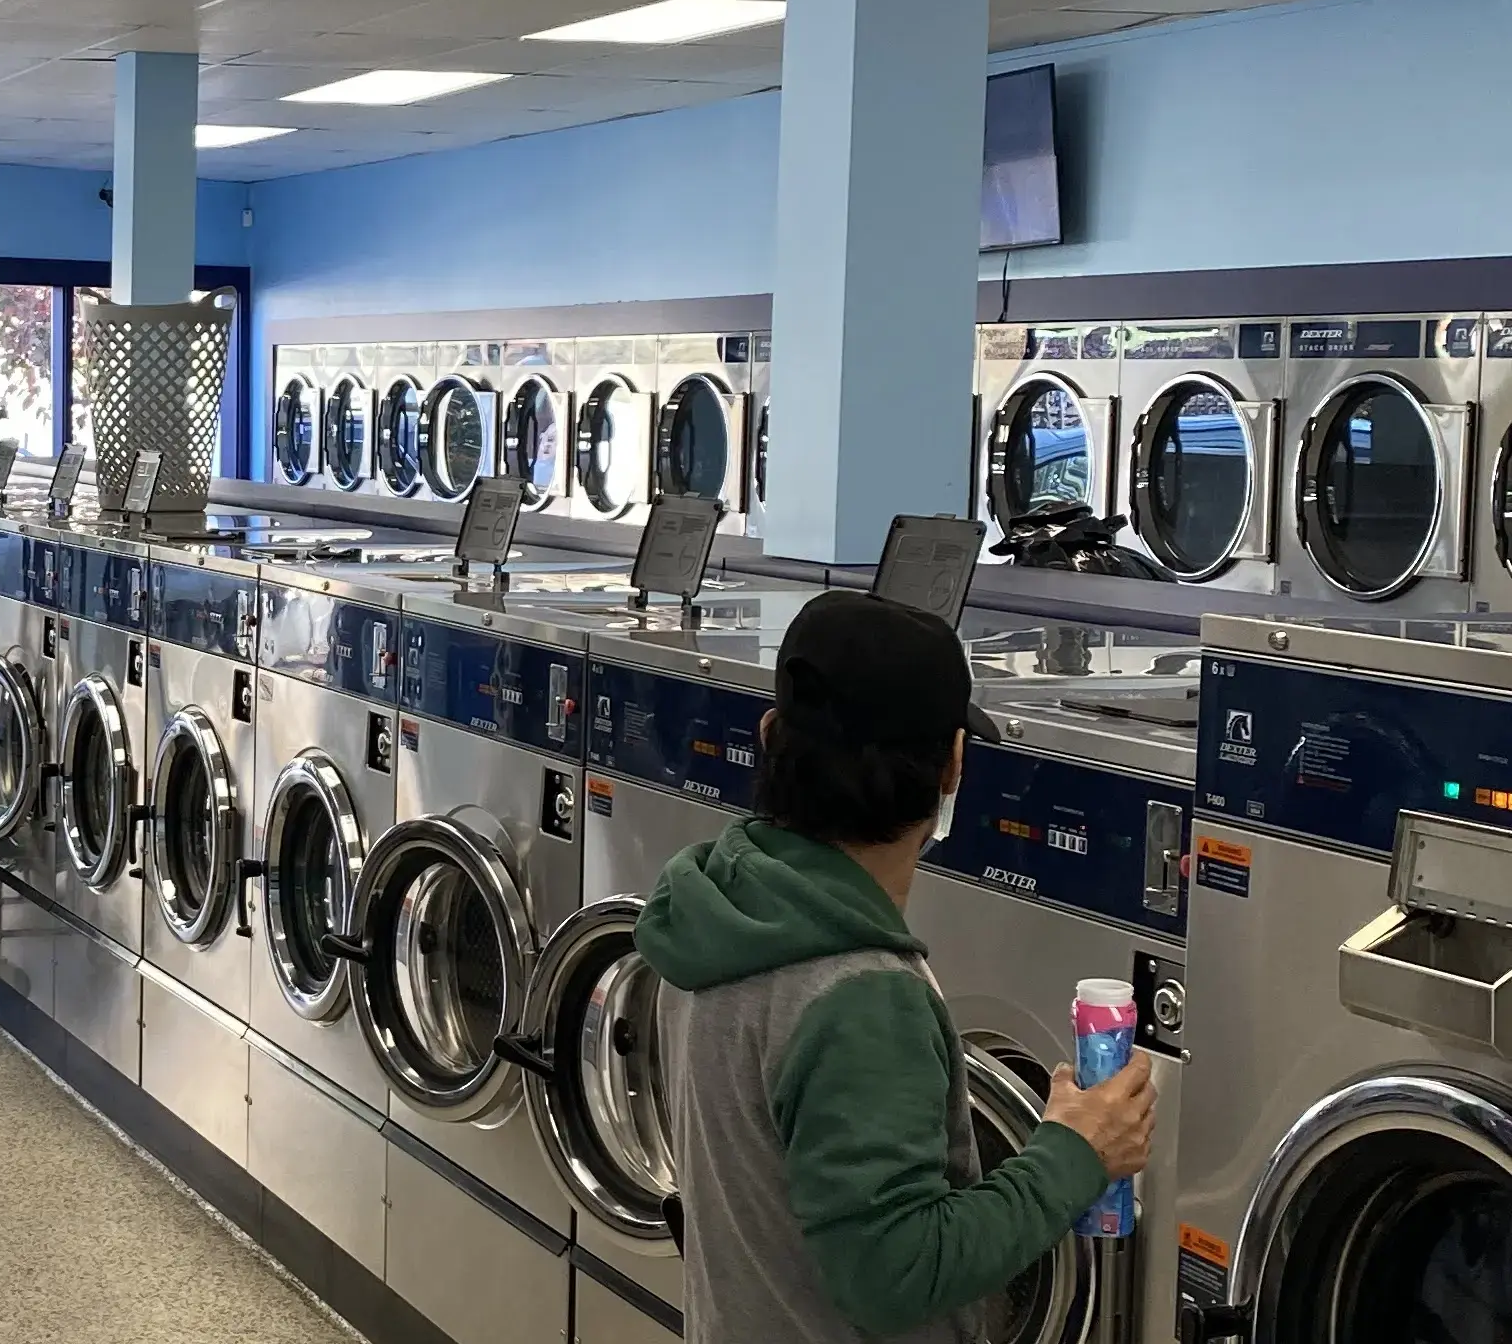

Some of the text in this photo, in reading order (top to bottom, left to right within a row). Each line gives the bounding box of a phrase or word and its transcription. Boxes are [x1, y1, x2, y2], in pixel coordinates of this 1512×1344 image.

[1300, 329, 1343, 338] DEXTER
[470, 716, 498, 731] DEXTER
[1219, 742, 1257, 757] DEXTER
[683, 779, 720, 798] DEXTER
[983, 865, 1037, 890] DEXTER
